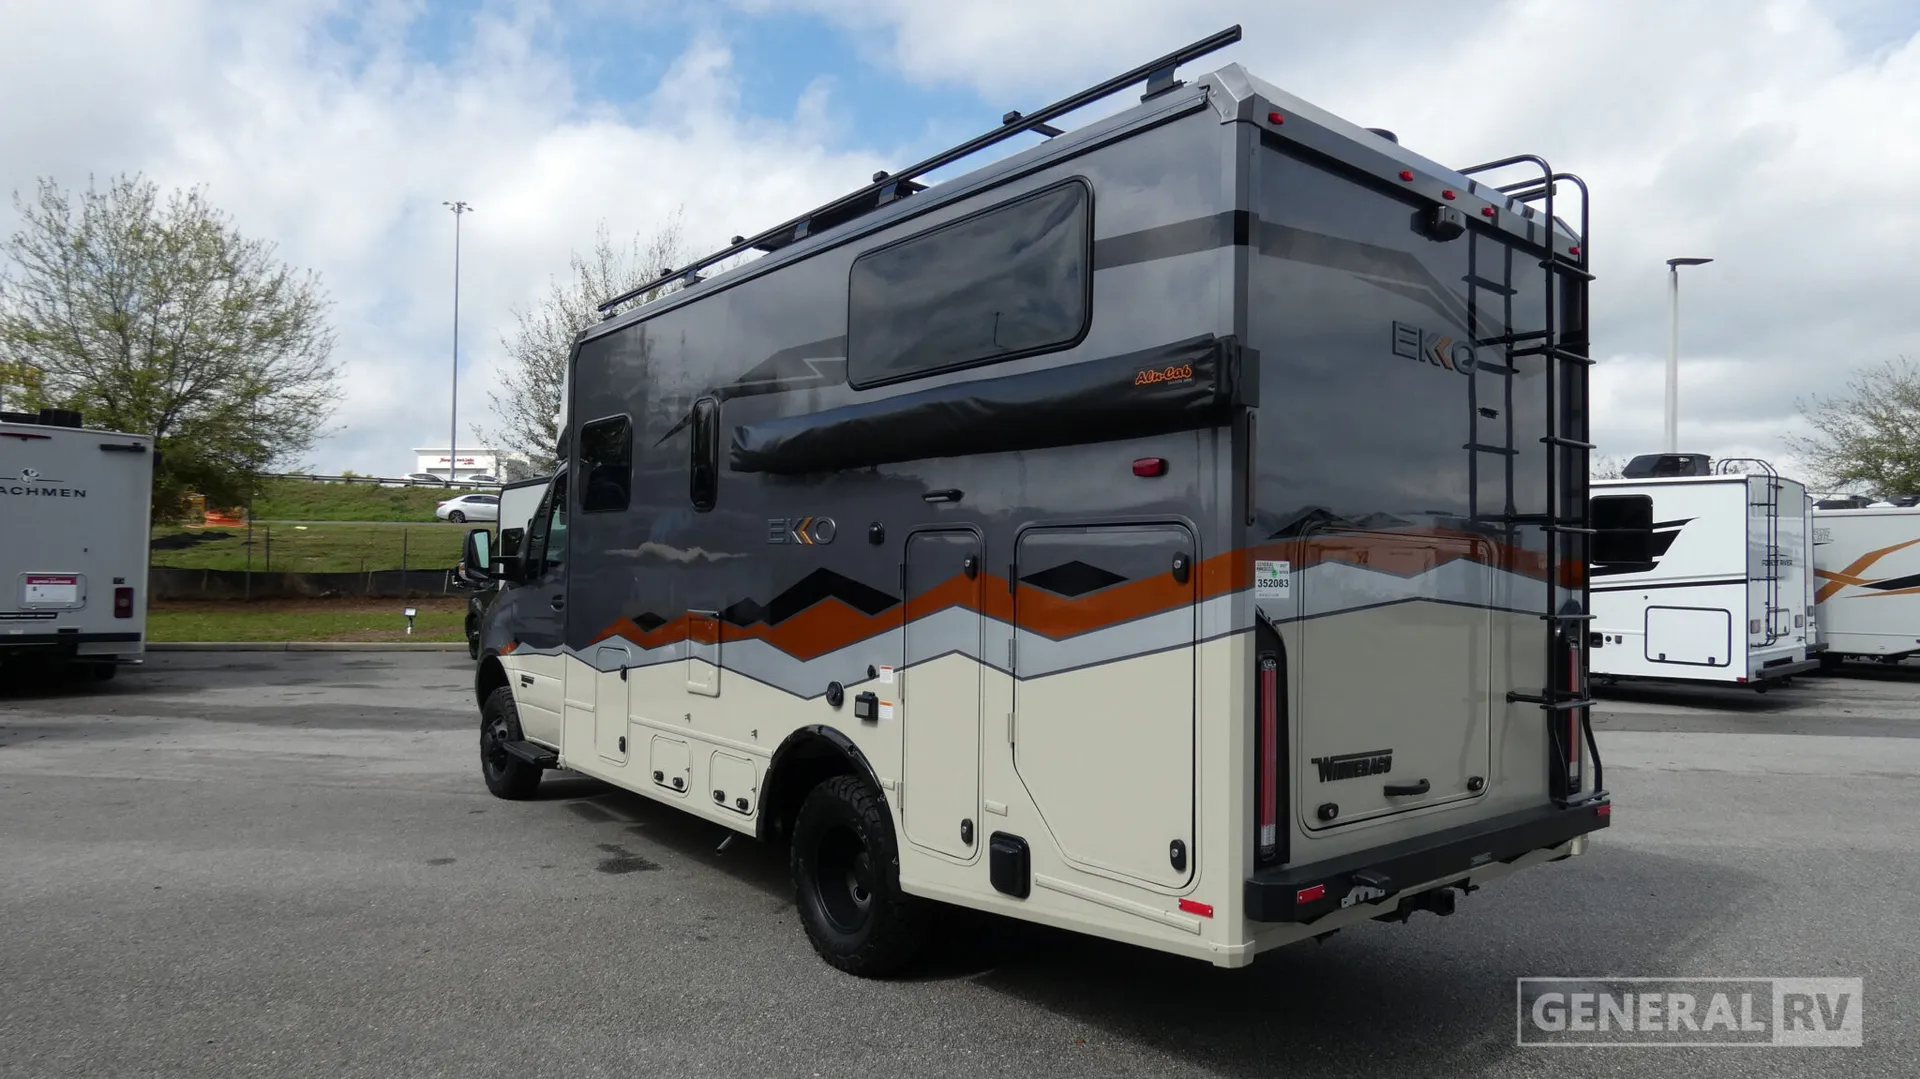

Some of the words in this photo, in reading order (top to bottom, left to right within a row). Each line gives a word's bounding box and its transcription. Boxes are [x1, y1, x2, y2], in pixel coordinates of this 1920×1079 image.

[1392, 320, 1477, 375] EKKO
[1135, 364, 1192, 385] Alu-Cab
[767, 517, 837, 545] EKKO
[1257, 578, 1289, 588] 352083
